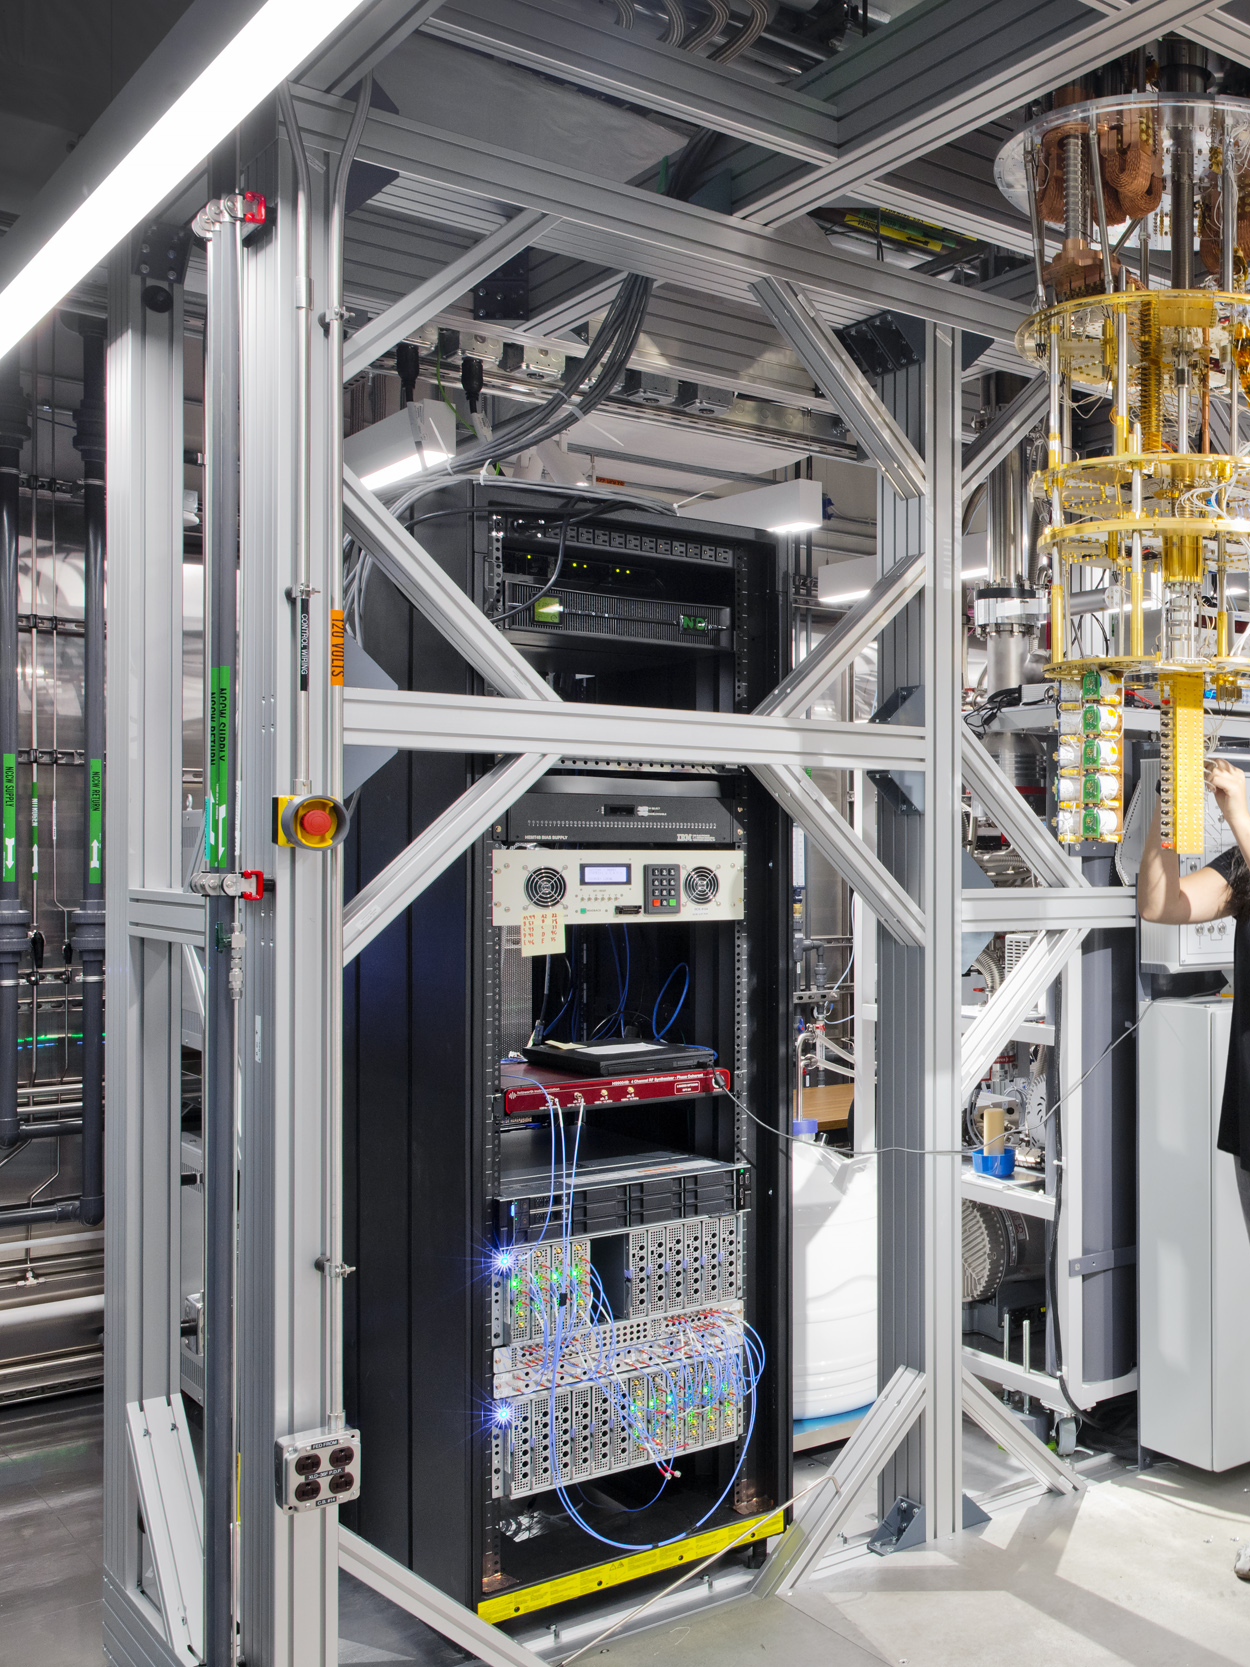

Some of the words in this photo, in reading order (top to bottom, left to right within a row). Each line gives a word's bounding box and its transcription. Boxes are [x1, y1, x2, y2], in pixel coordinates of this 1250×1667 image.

[301, 613, 309, 648] CONTROL
[331, 618, 344, 639] 120
[301, 649, 309, 675] WIRING
[331, 643, 344, 677] VOLTS
[5, 766, 14, 784] NCCW
[92, 771, 100, 789] NCCW
[5, 785, 14, 808] SUPPLY
[92, 790, 100, 812] RETURN
